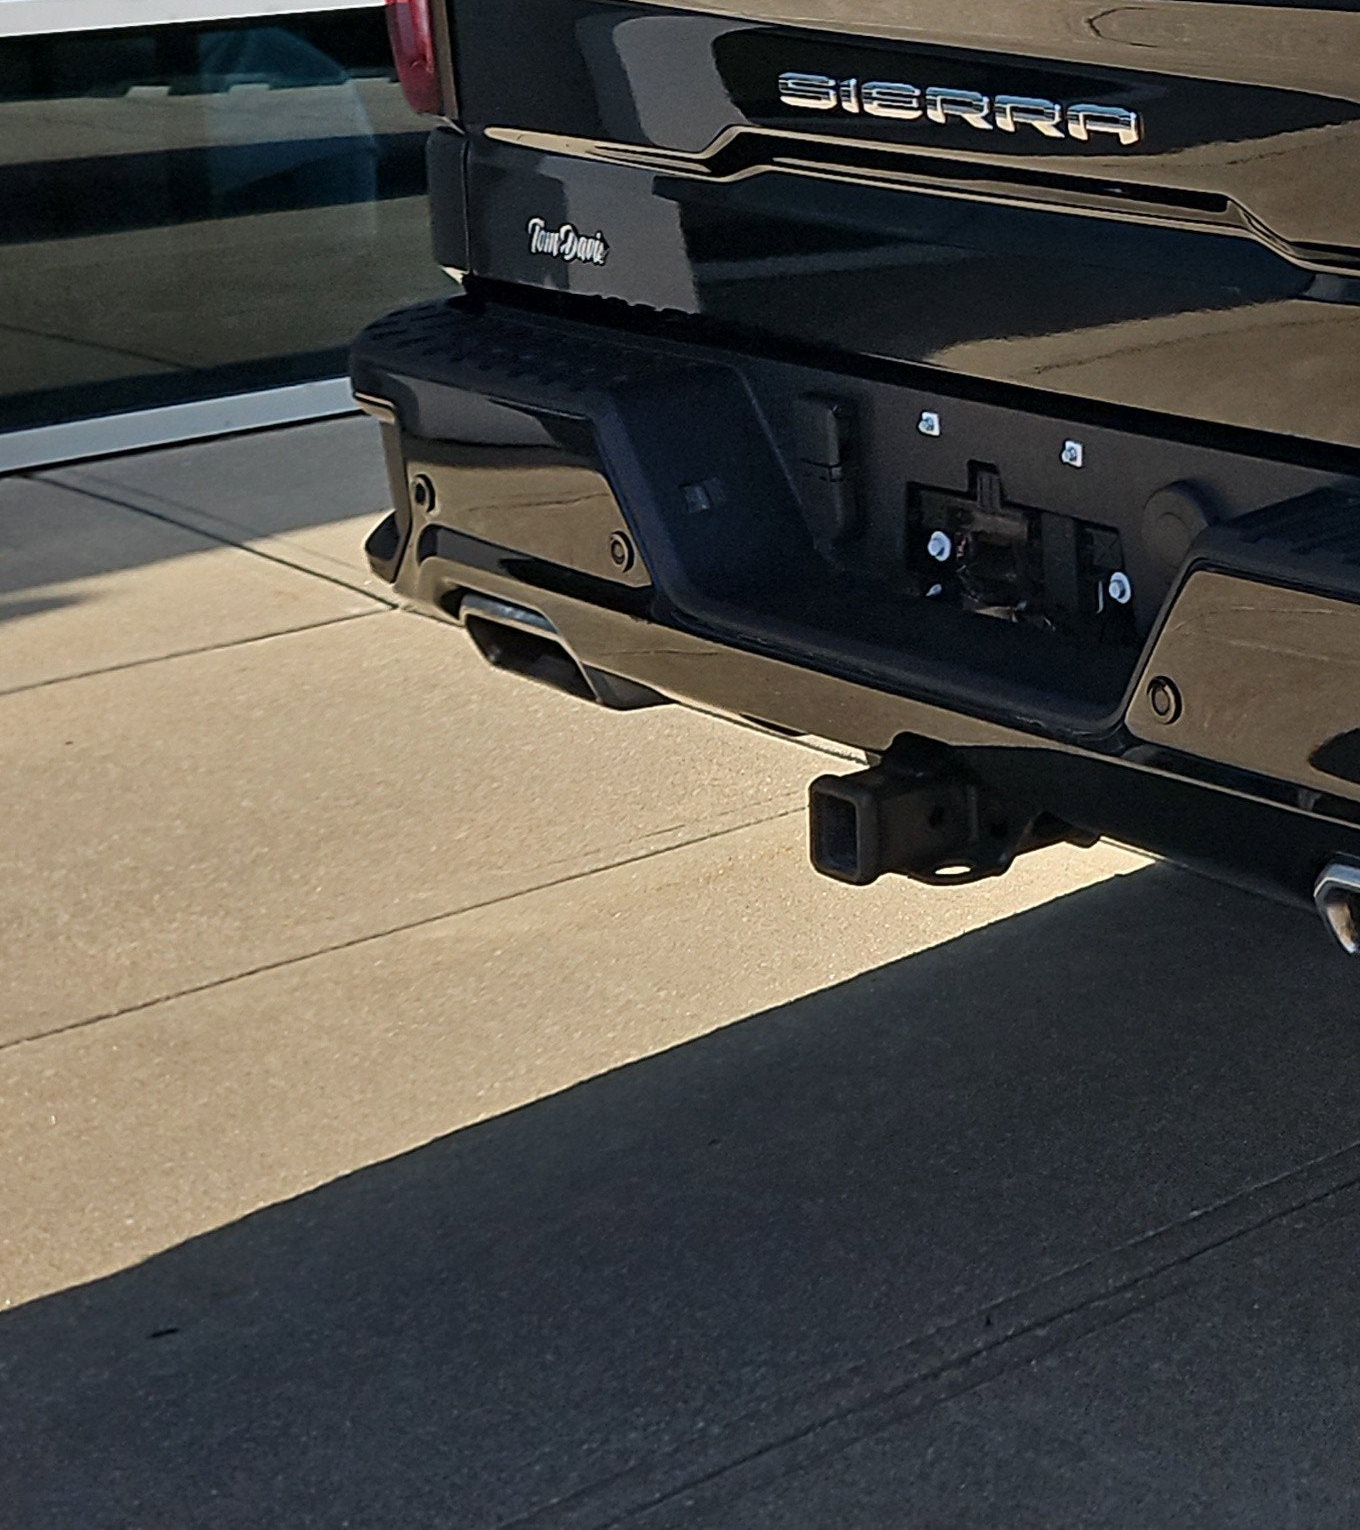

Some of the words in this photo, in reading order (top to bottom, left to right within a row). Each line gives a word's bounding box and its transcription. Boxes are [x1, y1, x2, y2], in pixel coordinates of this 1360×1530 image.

[778, 72, 1145, 147] SIERRA
[527, 216, 561, 258] Tom
[559, 223, 608, 266] Davis
